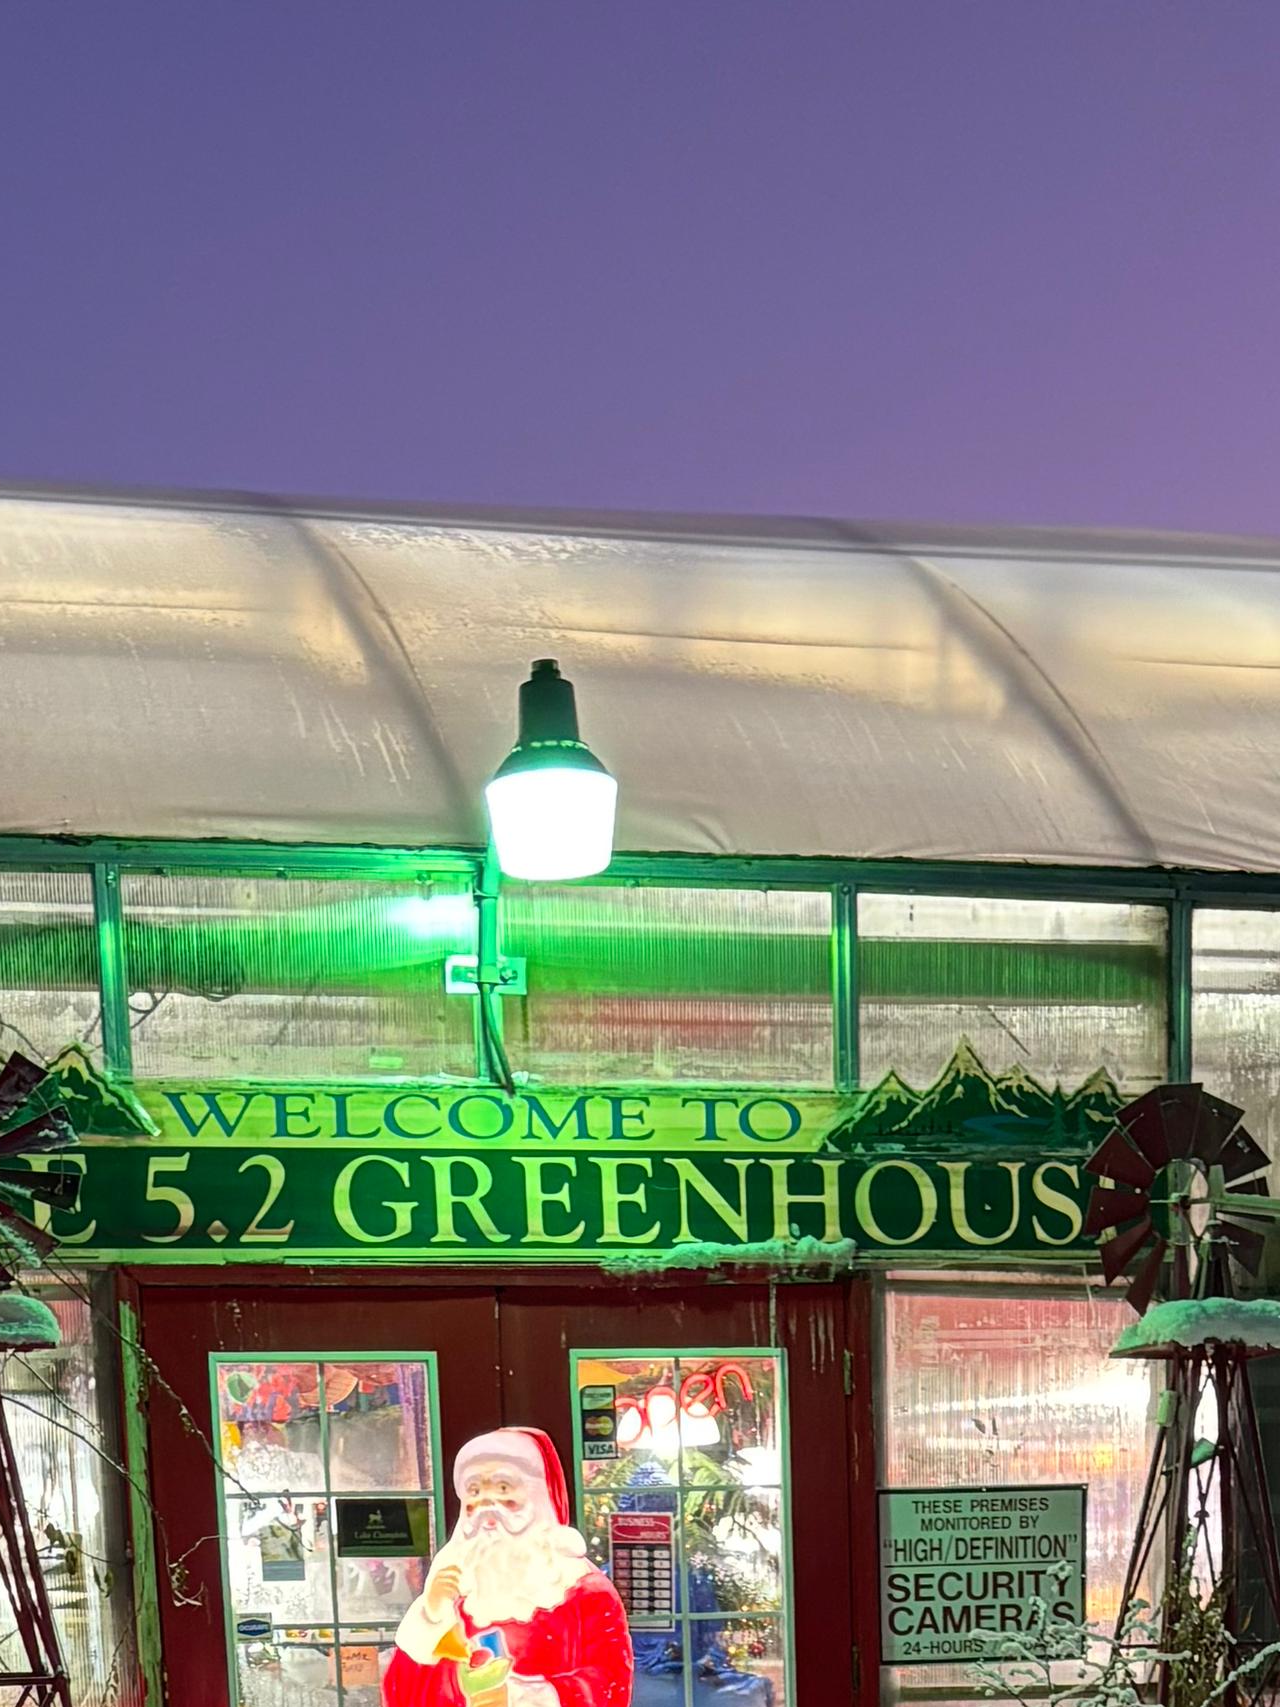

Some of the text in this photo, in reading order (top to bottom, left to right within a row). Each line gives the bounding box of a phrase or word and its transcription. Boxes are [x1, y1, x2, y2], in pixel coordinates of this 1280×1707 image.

[161, 1091, 802, 1143] WELCOME TO
[141, 1152, 296, 1243] 5.2
[332, 1154, 1118, 1246] GREENHOUS
[587, 1443, 614, 1455] VISA
[912, 1497, 1050, 1515] THESE PREMISES
[920, 1515, 1040, 1532] MONITORED BY
[887, 1570, 1070, 1604] SECURITY
[888, 1601, 1076, 1636] CAMERAS
[903, 1639, 985, 1656] 24-HOURS
